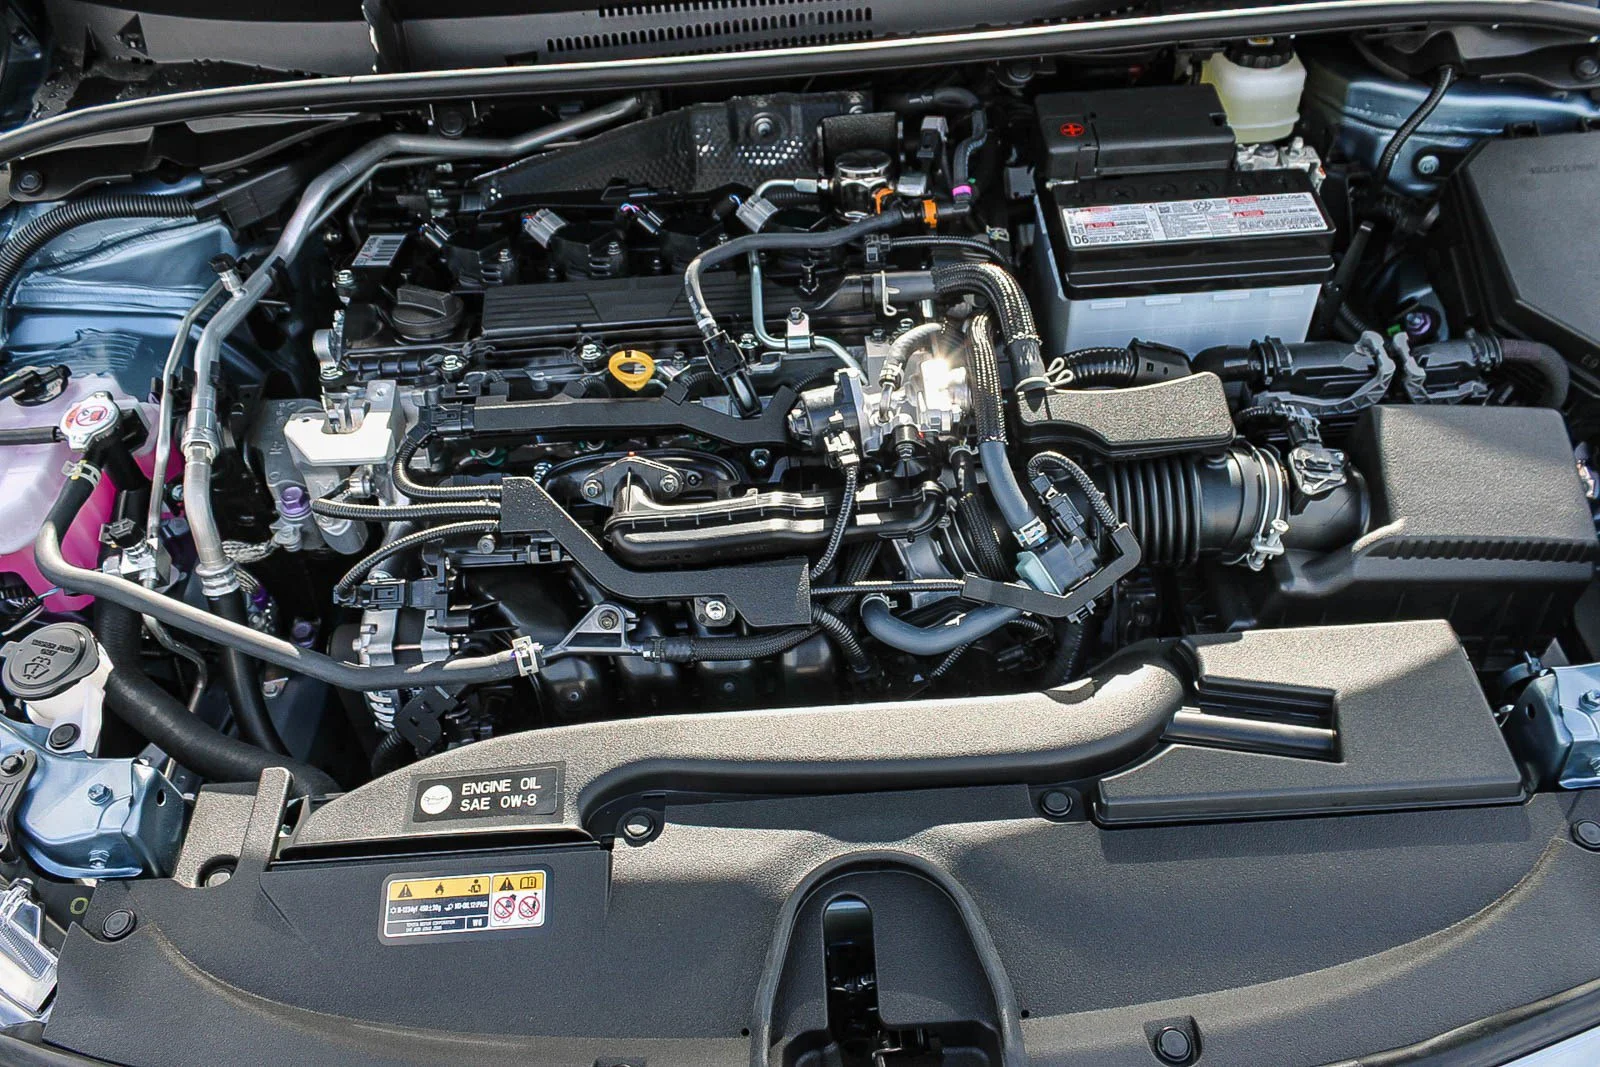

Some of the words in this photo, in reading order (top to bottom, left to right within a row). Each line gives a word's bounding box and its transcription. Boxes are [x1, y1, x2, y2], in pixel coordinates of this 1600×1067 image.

[1073, 235, 1089, 245] D6
[462, 779, 511, 795] ENGINE
[520, 777, 541, 790] OIL
[459, 796, 491, 812] SAE
[500, 793, 537, 809] 0W-8
